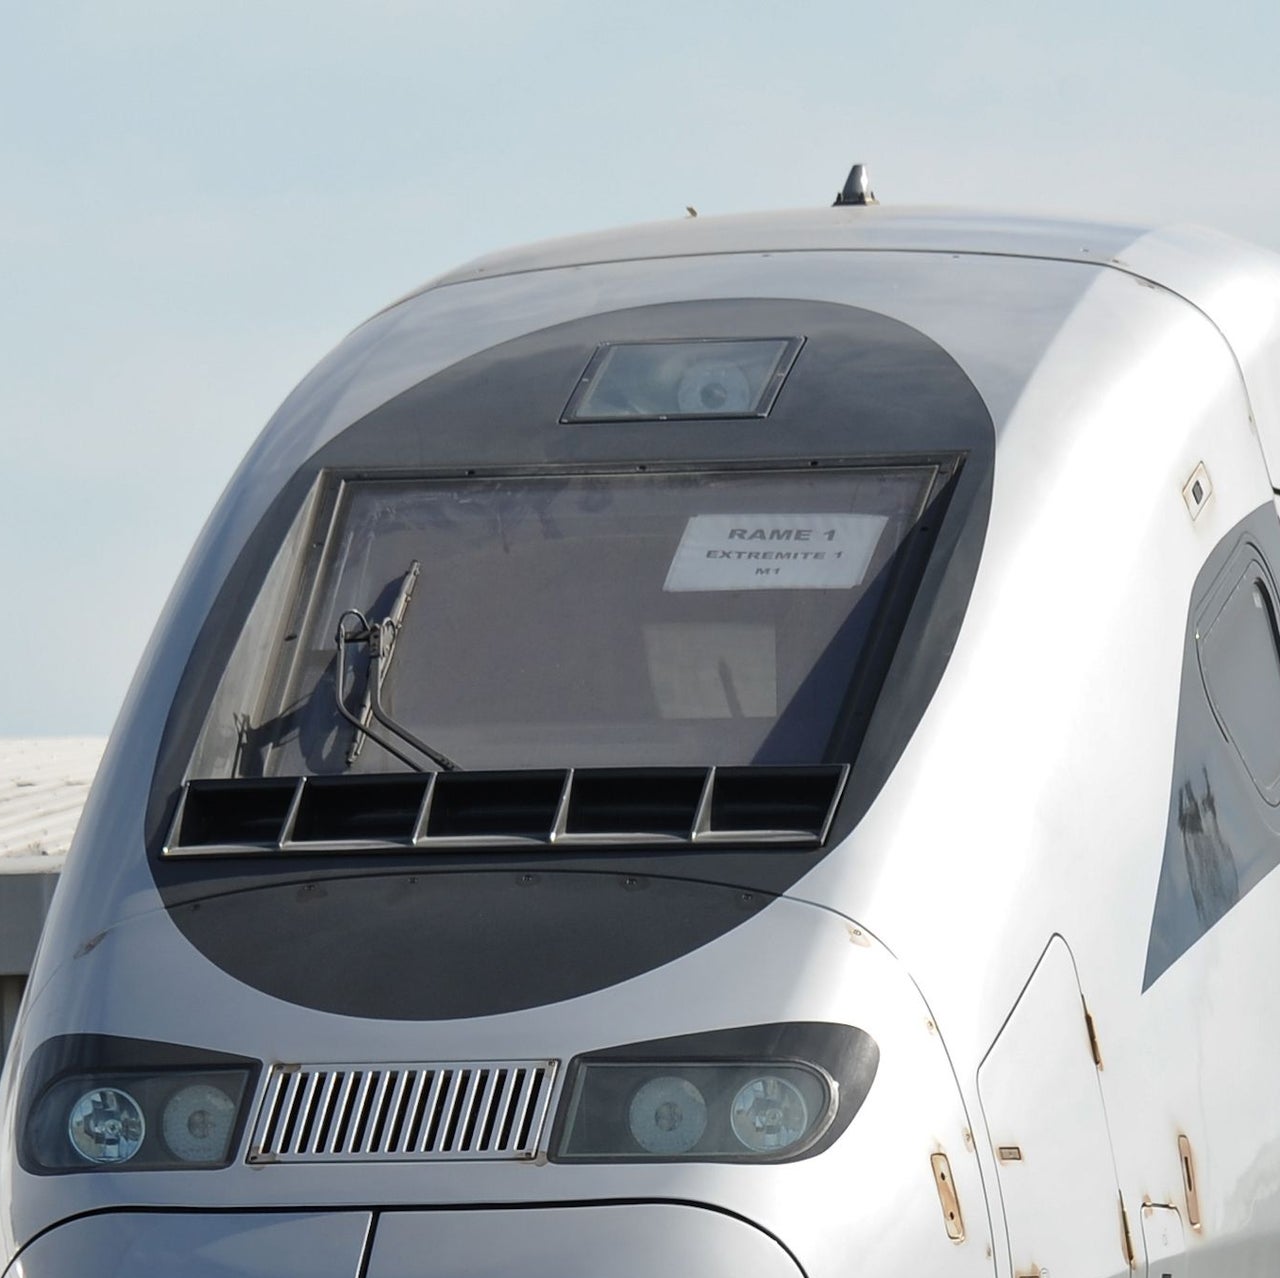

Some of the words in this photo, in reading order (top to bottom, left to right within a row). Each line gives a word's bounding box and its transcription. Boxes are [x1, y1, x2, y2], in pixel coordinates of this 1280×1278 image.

[728, 528, 812, 541] RAME
[824, 529, 836, 541] 1
[706, 550, 825, 560] EXTREMITE
[834, 551, 842, 559] 1
[755, 567, 780, 575] M1
